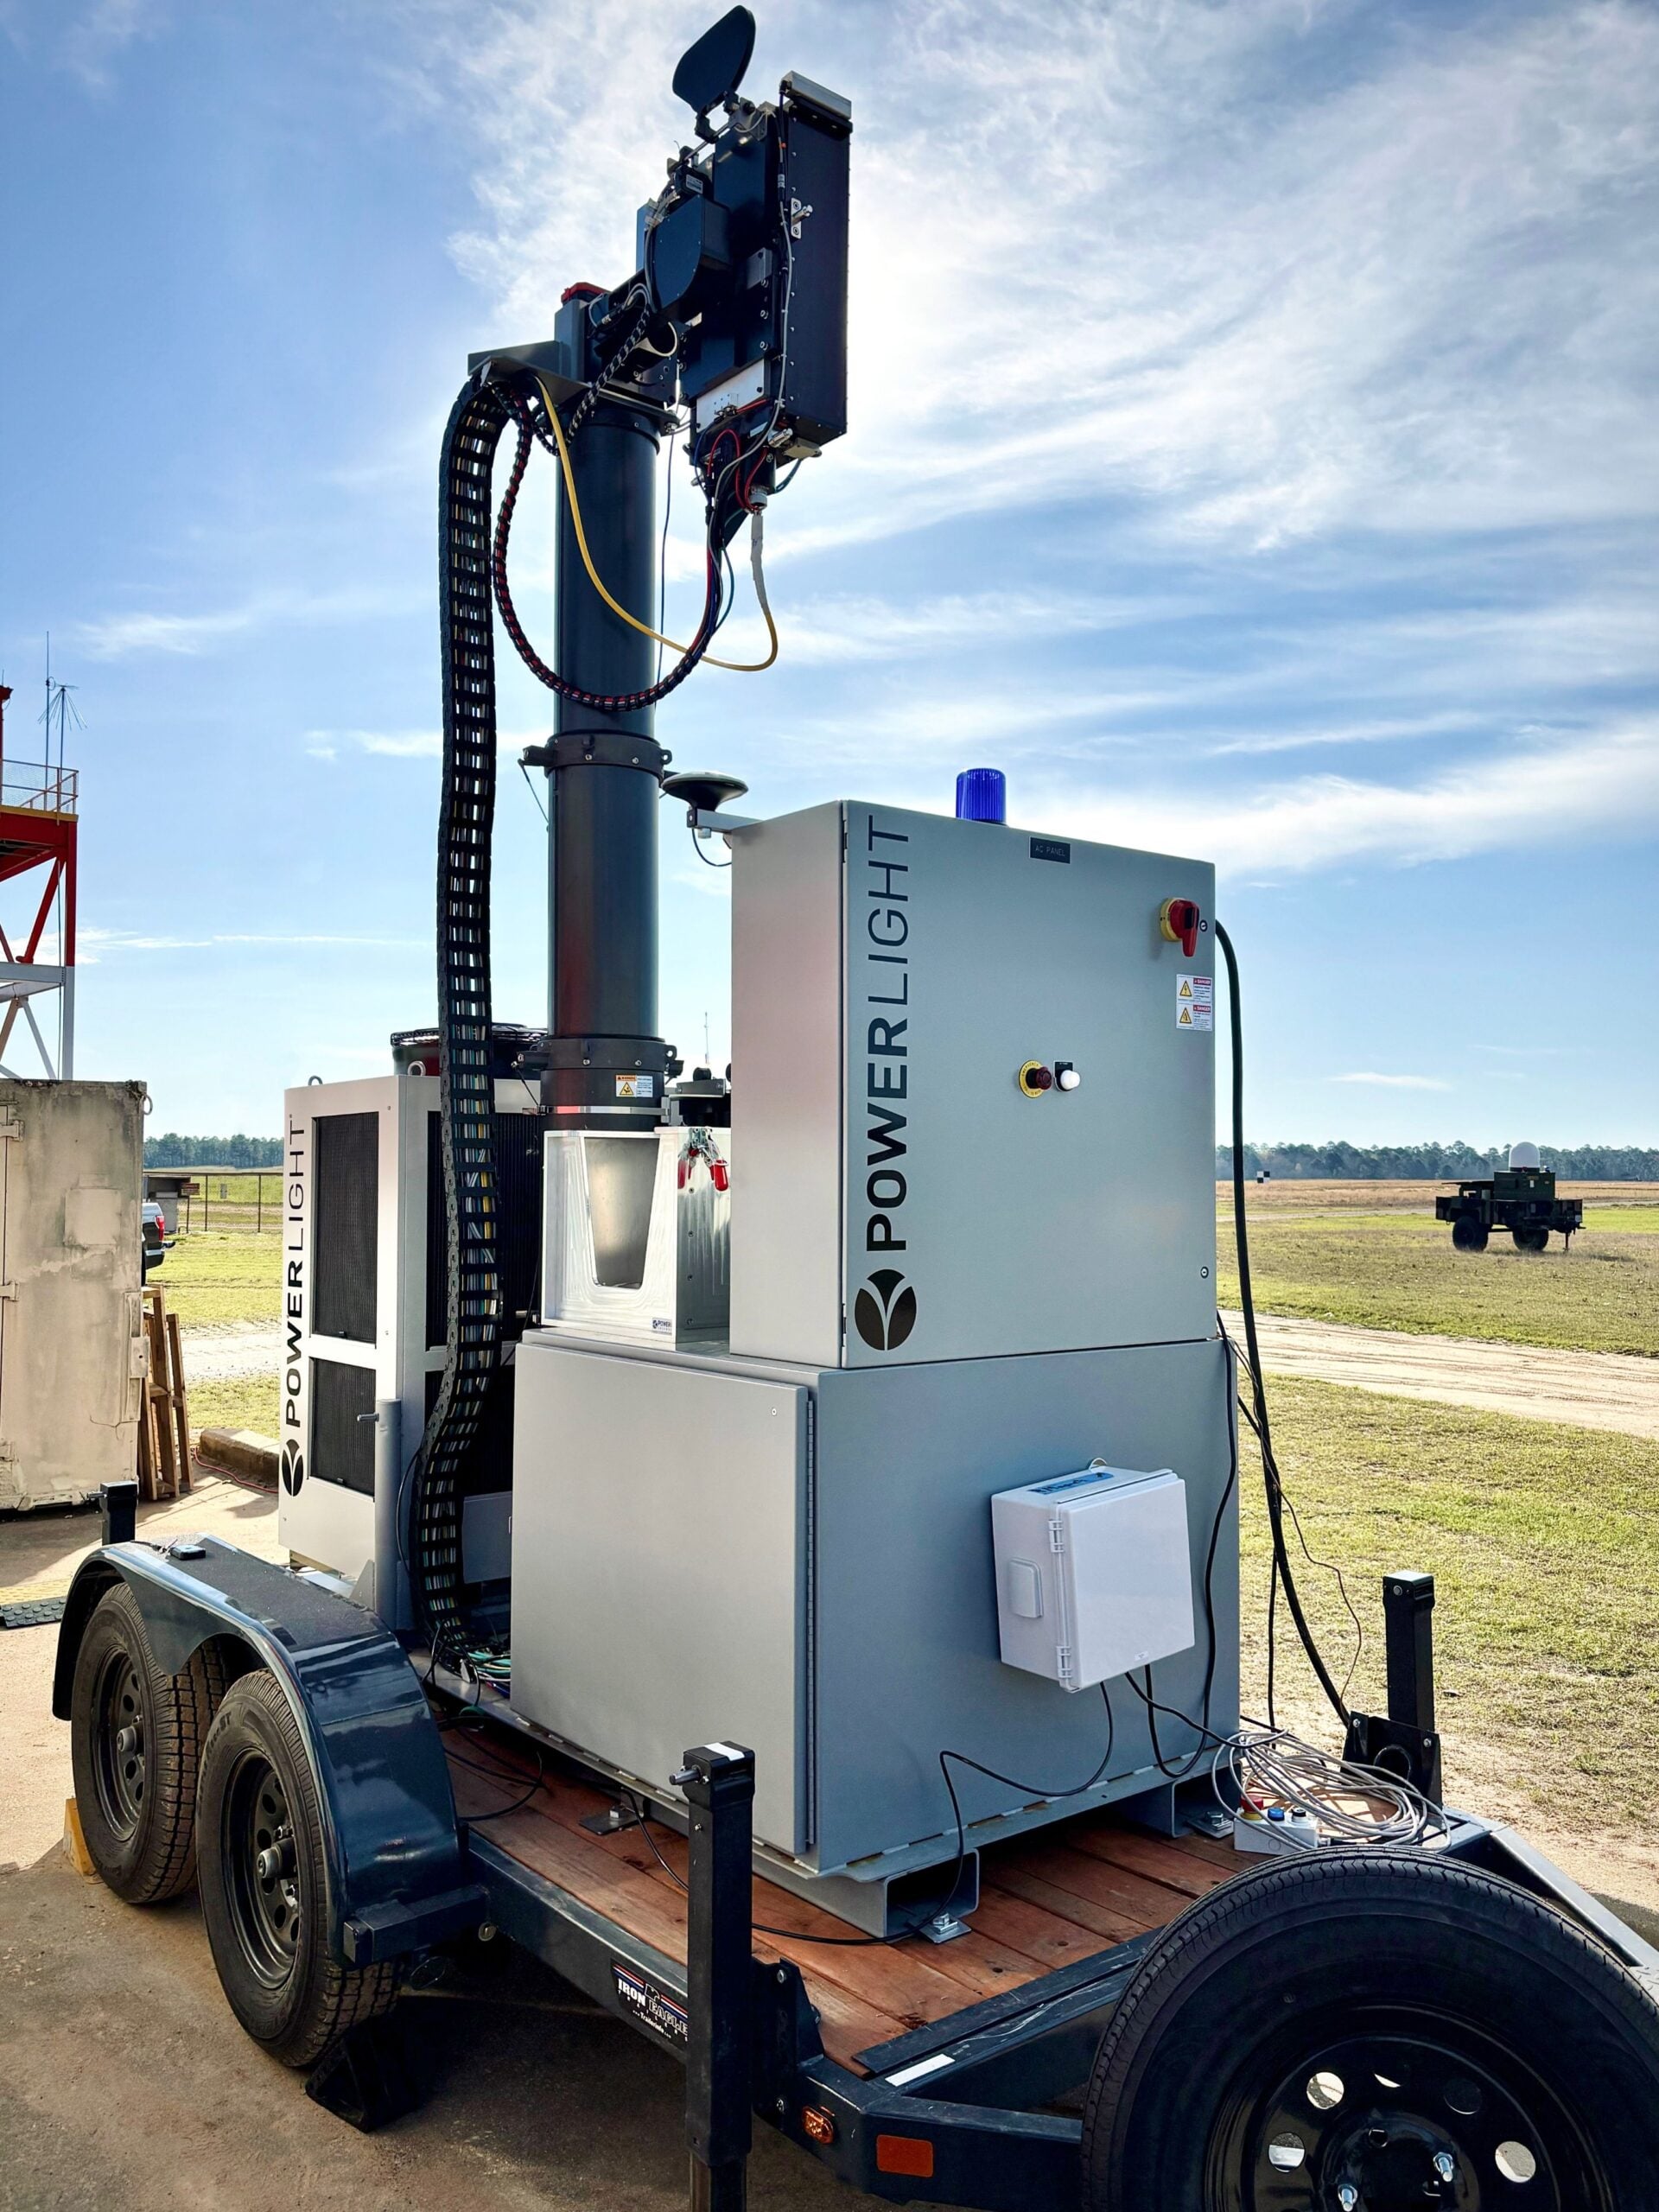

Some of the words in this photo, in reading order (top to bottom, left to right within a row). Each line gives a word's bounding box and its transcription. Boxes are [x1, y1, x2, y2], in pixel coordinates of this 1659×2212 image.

[1046, 847, 1065, 856] PANEL
[866, 814, 910, 1252] POWERLIGHT
[285, 1118, 305, 1428] POWERLIGHT
[618, 1978, 646, 2006] IRON
[649, 1999, 688, 2037] EAGLE
